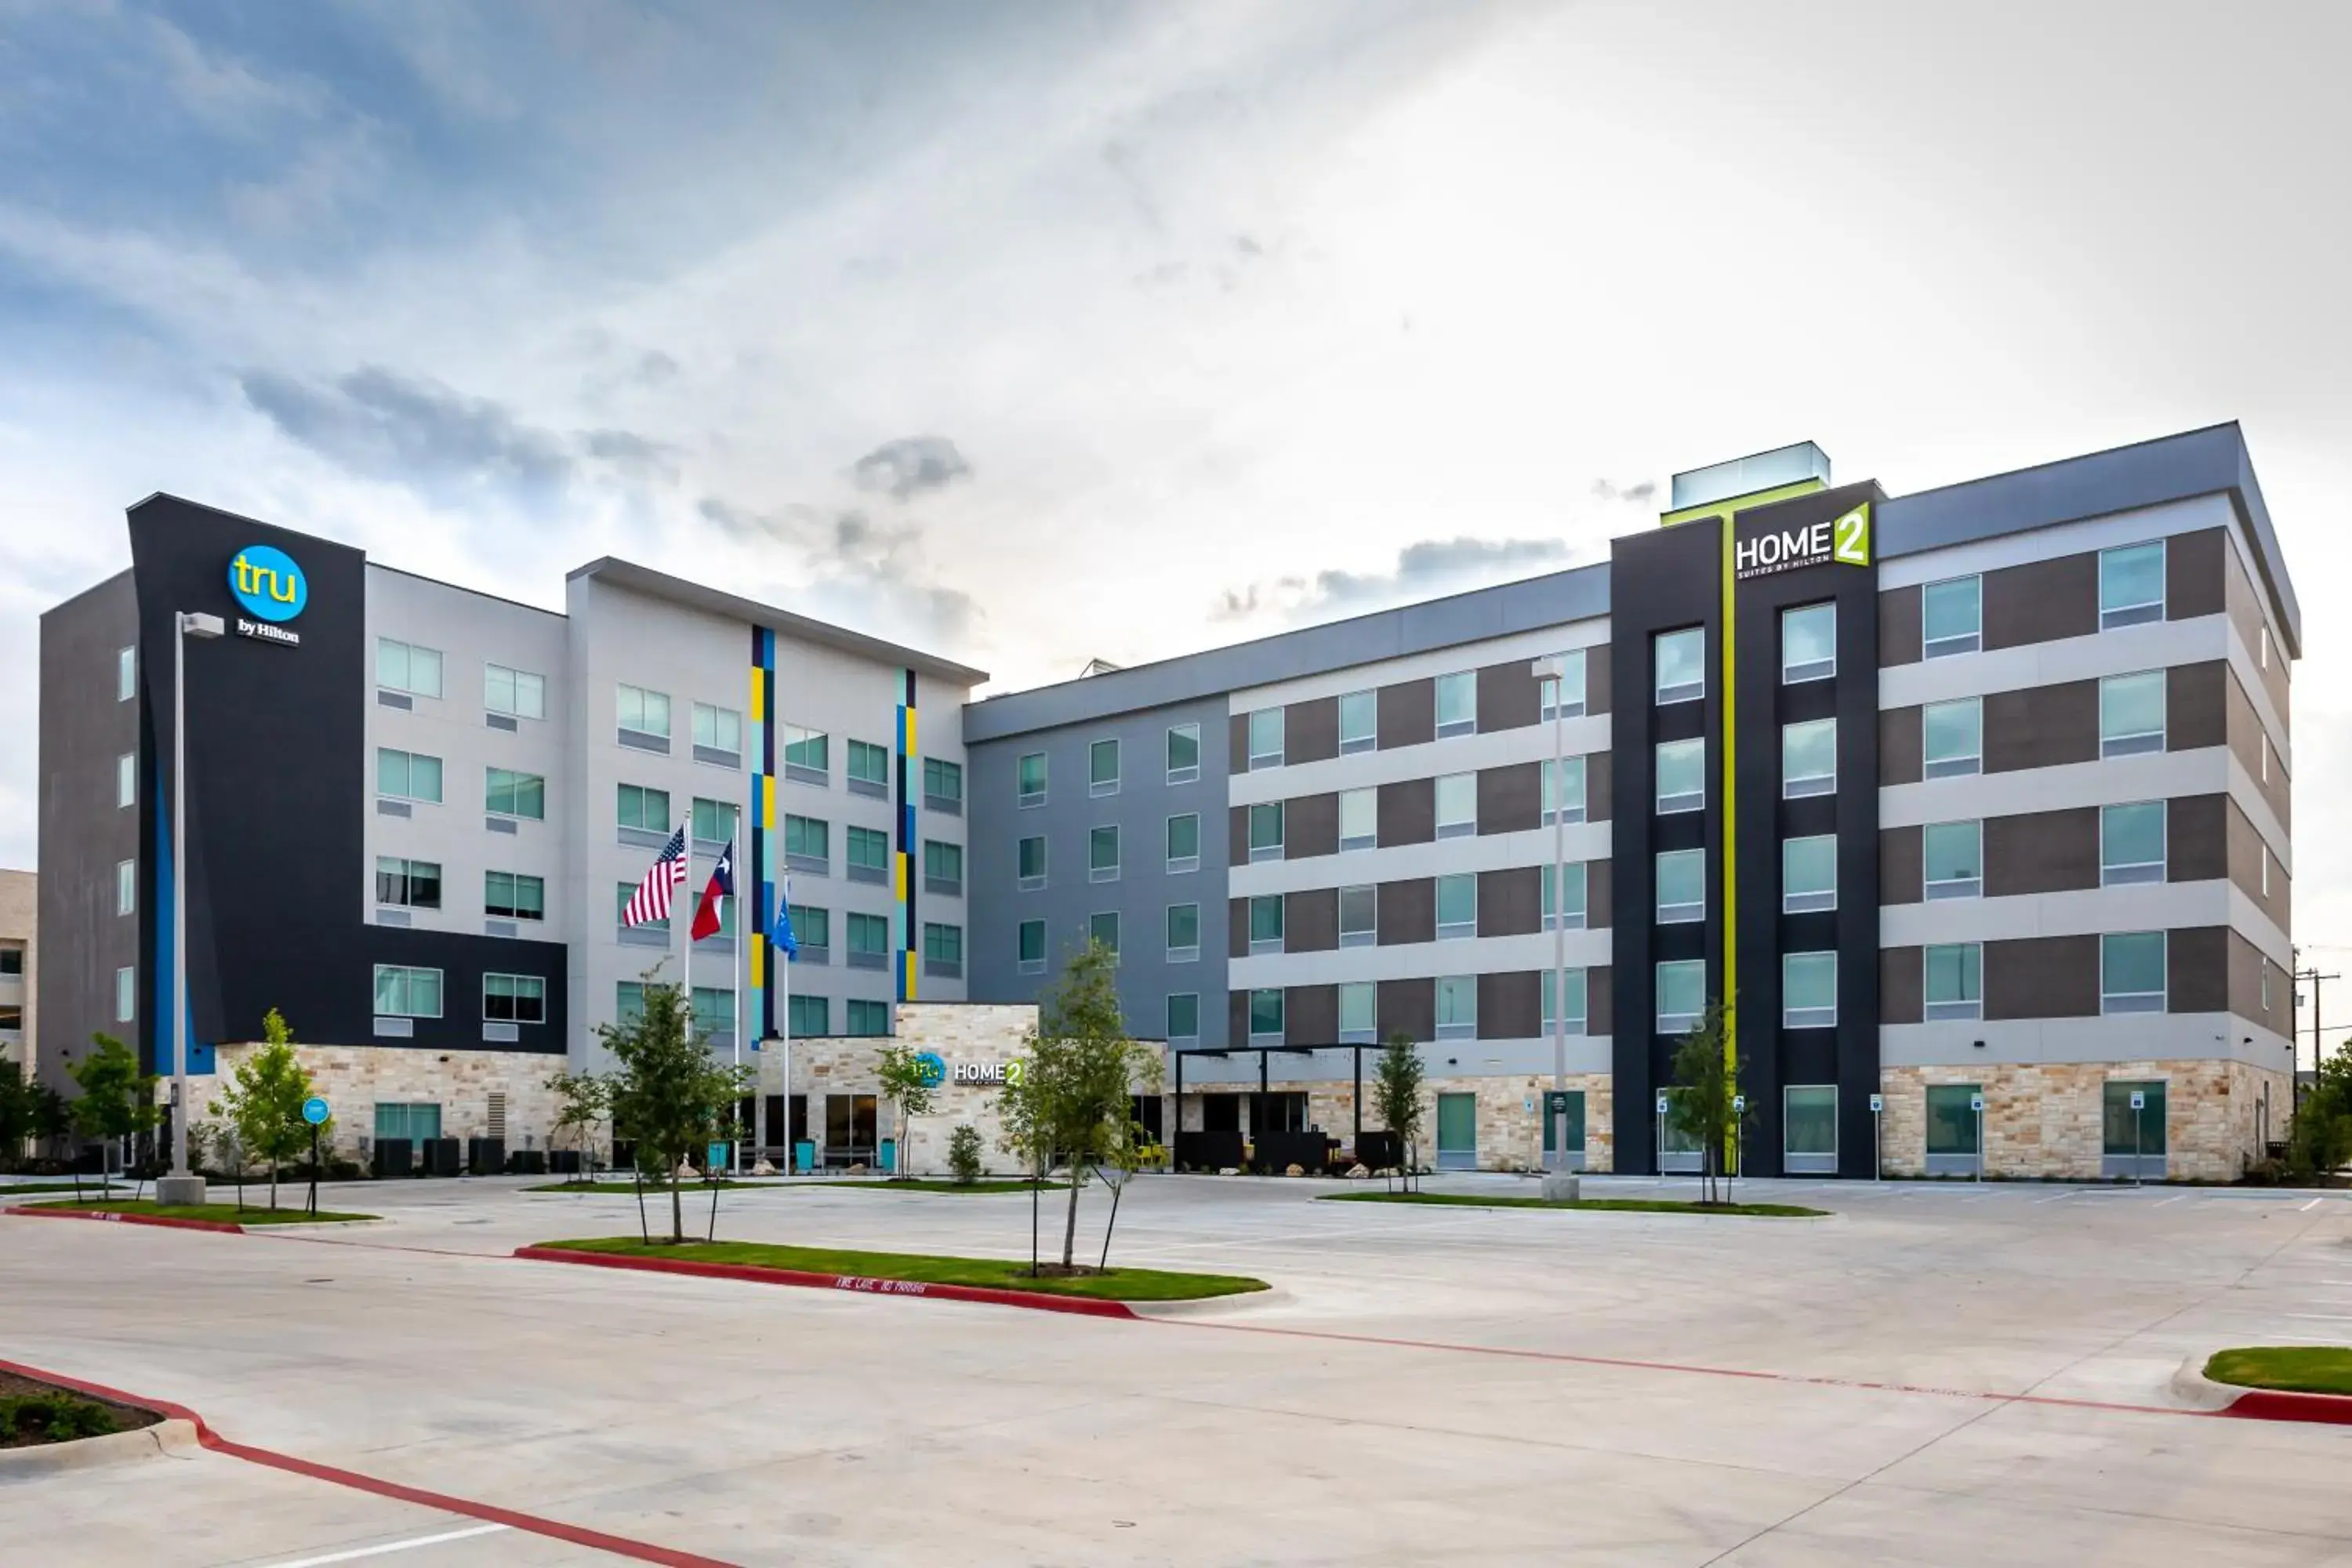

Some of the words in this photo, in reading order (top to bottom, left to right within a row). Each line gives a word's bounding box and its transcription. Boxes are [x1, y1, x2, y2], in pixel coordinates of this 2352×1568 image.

[233, 554, 296, 603] tru
[1737, 565, 1773, 579] SUITES
[1792, 555, 1830, 568] HILTON
[238, 618, 256, 636] by
[257, 623, 299, 644] Hilton
